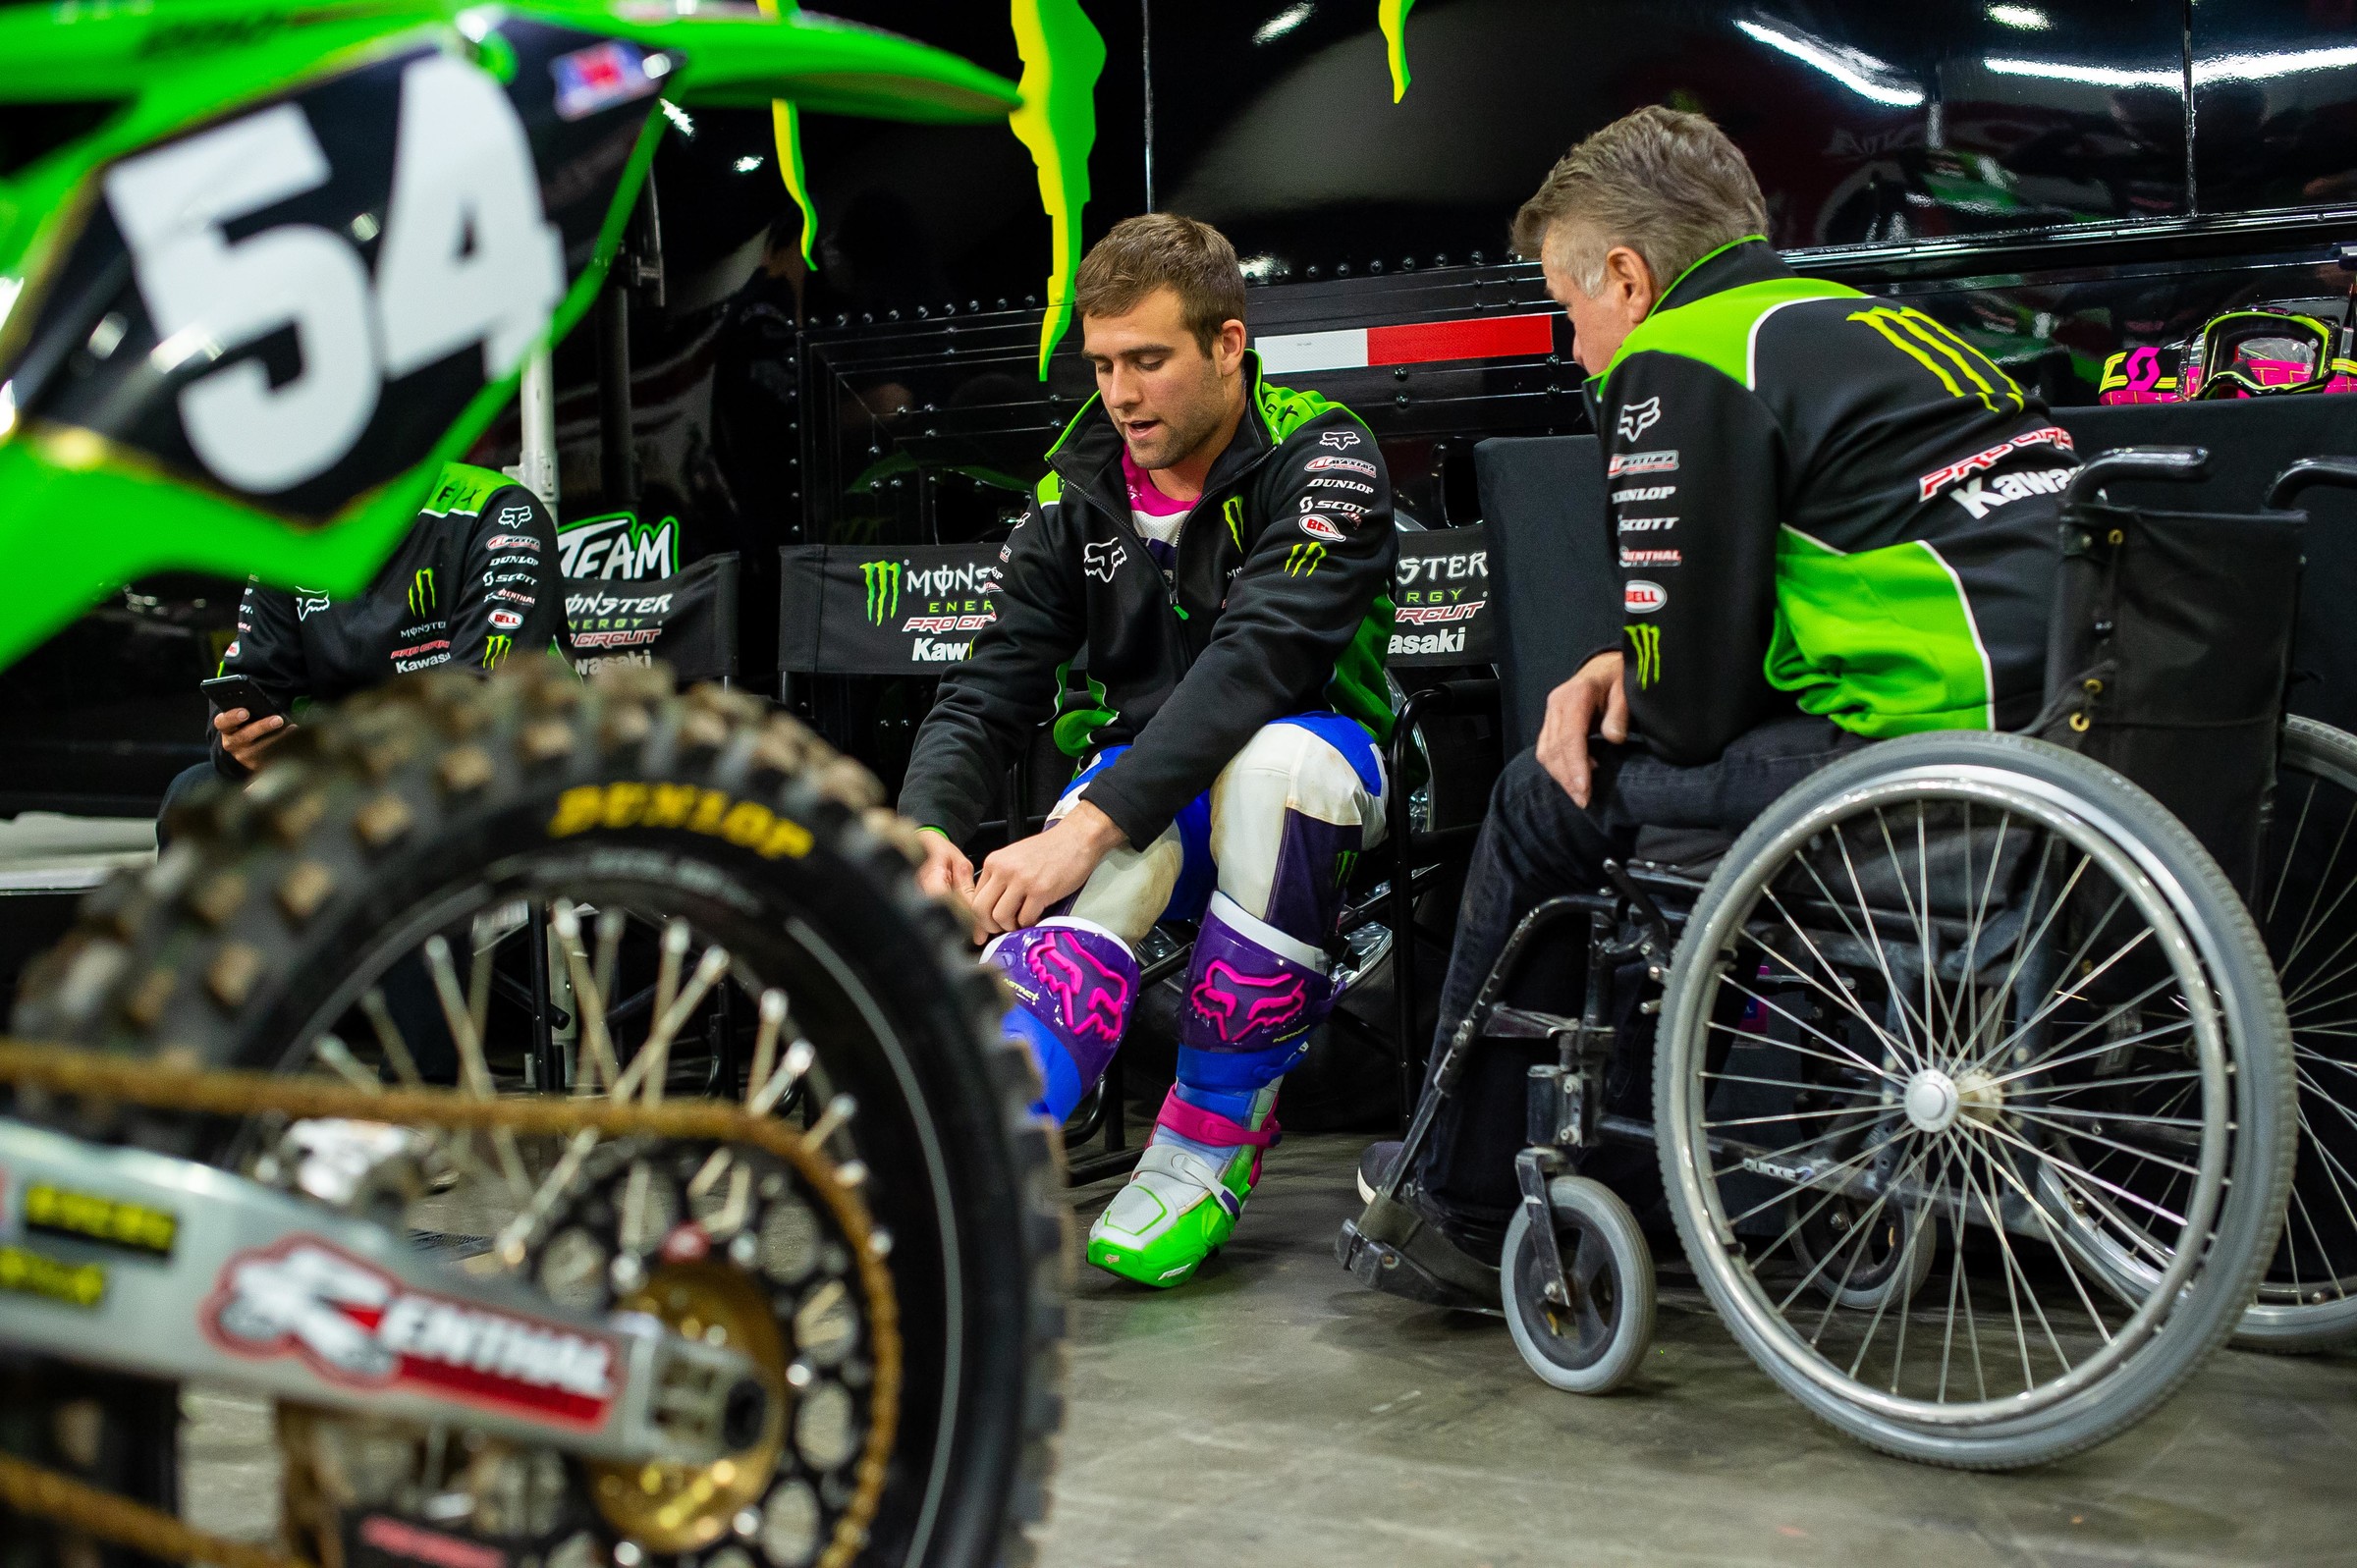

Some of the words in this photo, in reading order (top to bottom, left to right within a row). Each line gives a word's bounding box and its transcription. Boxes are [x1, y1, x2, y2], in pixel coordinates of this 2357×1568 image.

[104, 51, 567, 495] 54
[1307, 479, 1374, 494] DUNLOP
[1620, 517, 1679, 531] SCOTT
[558, 518, 671, 579] TEAM
[494, 614, 519, 624] BELL
[902, 617, 958, 634] PRO
[575, 628, 662, 648] CIRCUIT
[548, 783, 814, 860] DUNLOP
